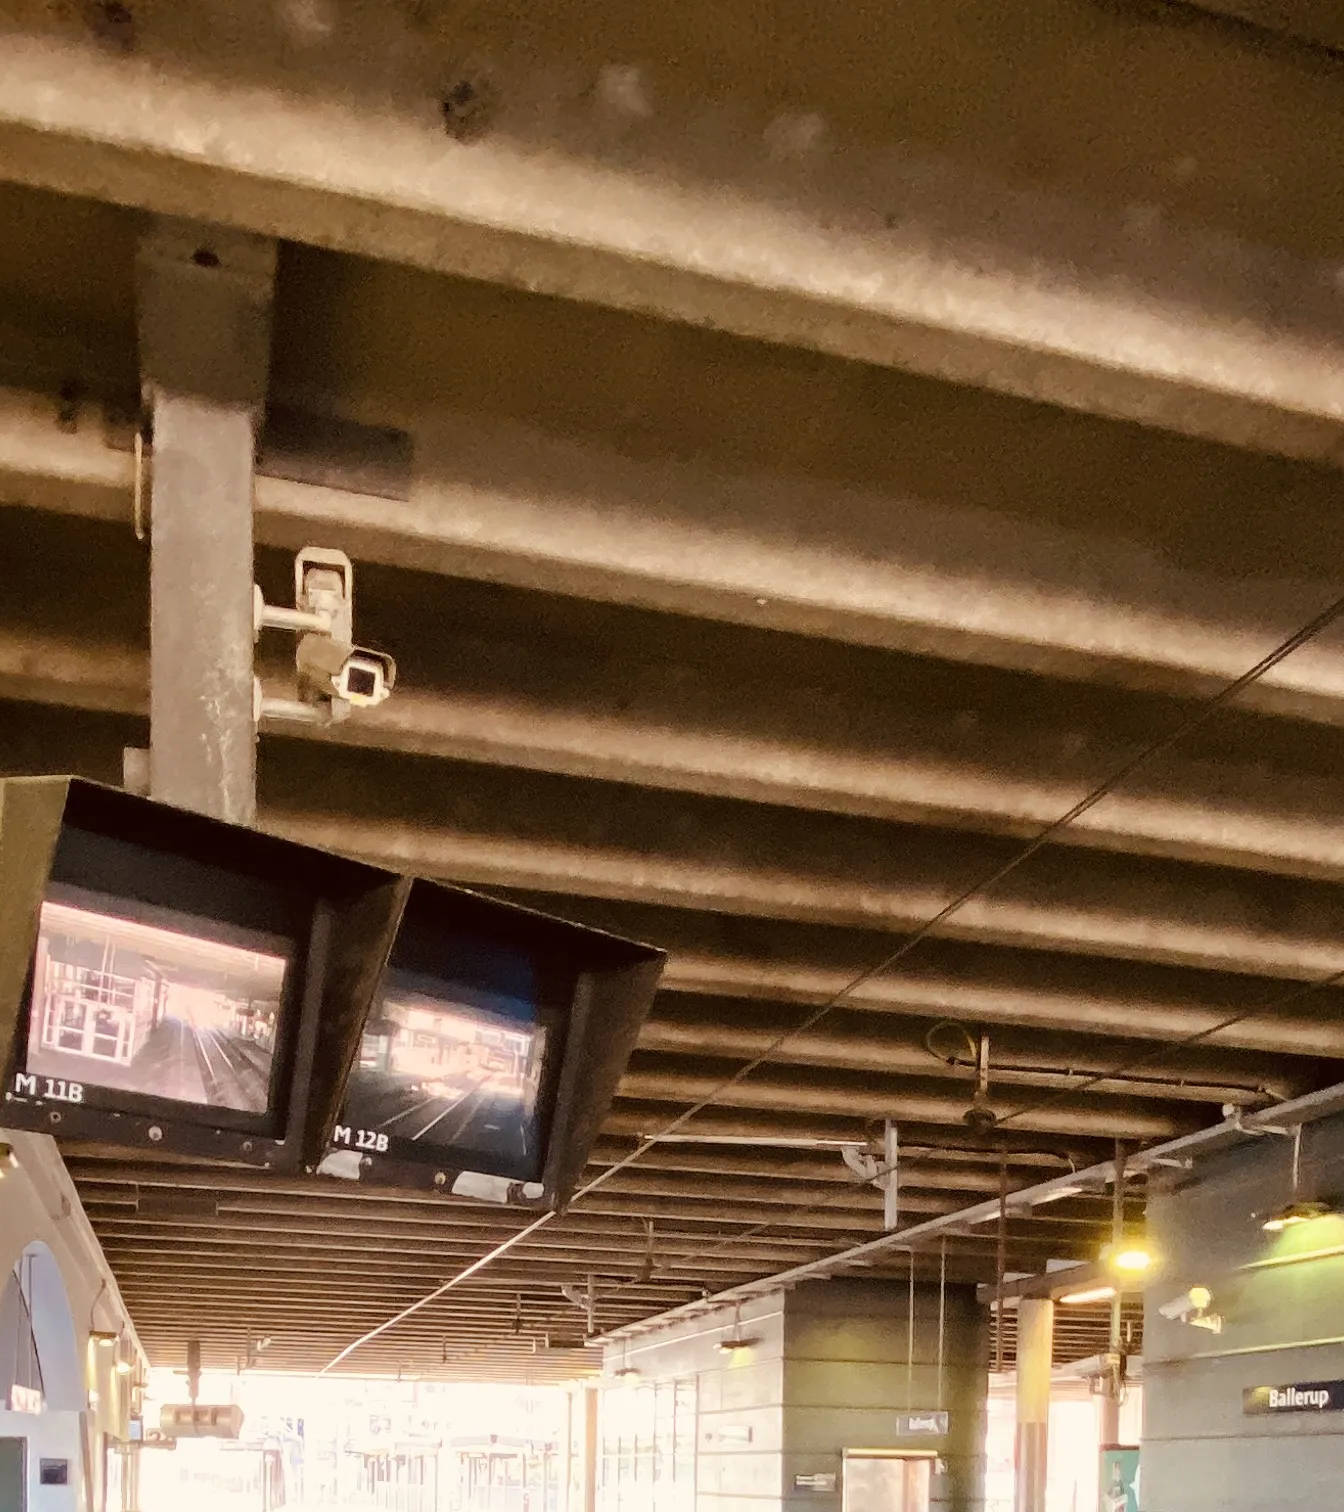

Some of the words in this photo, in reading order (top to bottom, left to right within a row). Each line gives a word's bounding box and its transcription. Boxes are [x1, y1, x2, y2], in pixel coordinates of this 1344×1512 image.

[15, 1072, 37, 1096] M
[43, 1079, 84, 1103] 11B
[333, 1124, 352, 1145] M
[354, 1128, 390, 1153] 12B
[1268, 1386, 1330, 1409] Ballerup
